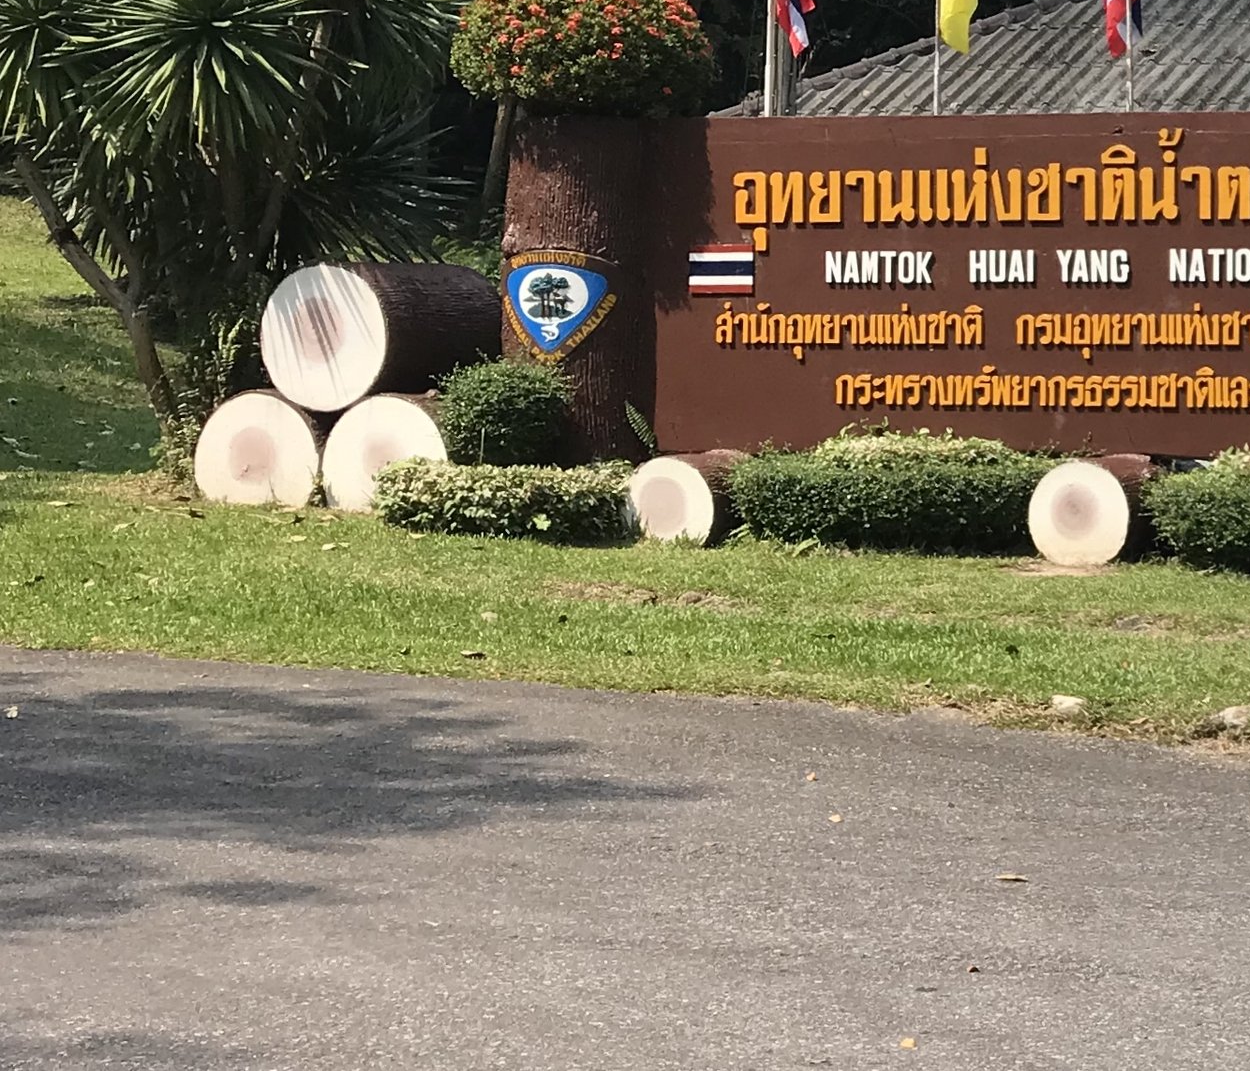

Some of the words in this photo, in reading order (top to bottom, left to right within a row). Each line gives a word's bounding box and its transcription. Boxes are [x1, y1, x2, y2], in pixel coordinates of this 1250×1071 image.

[824, 249, 933, 284] NAMTOK
[968, 248, 1036, 284] HUAI
[1055, 248, 1130, 284] YANG
[566, 294, 618, 348] THAILAND
[714, 301, 984, 360] สำนักอุทยานแห่งชาติ
